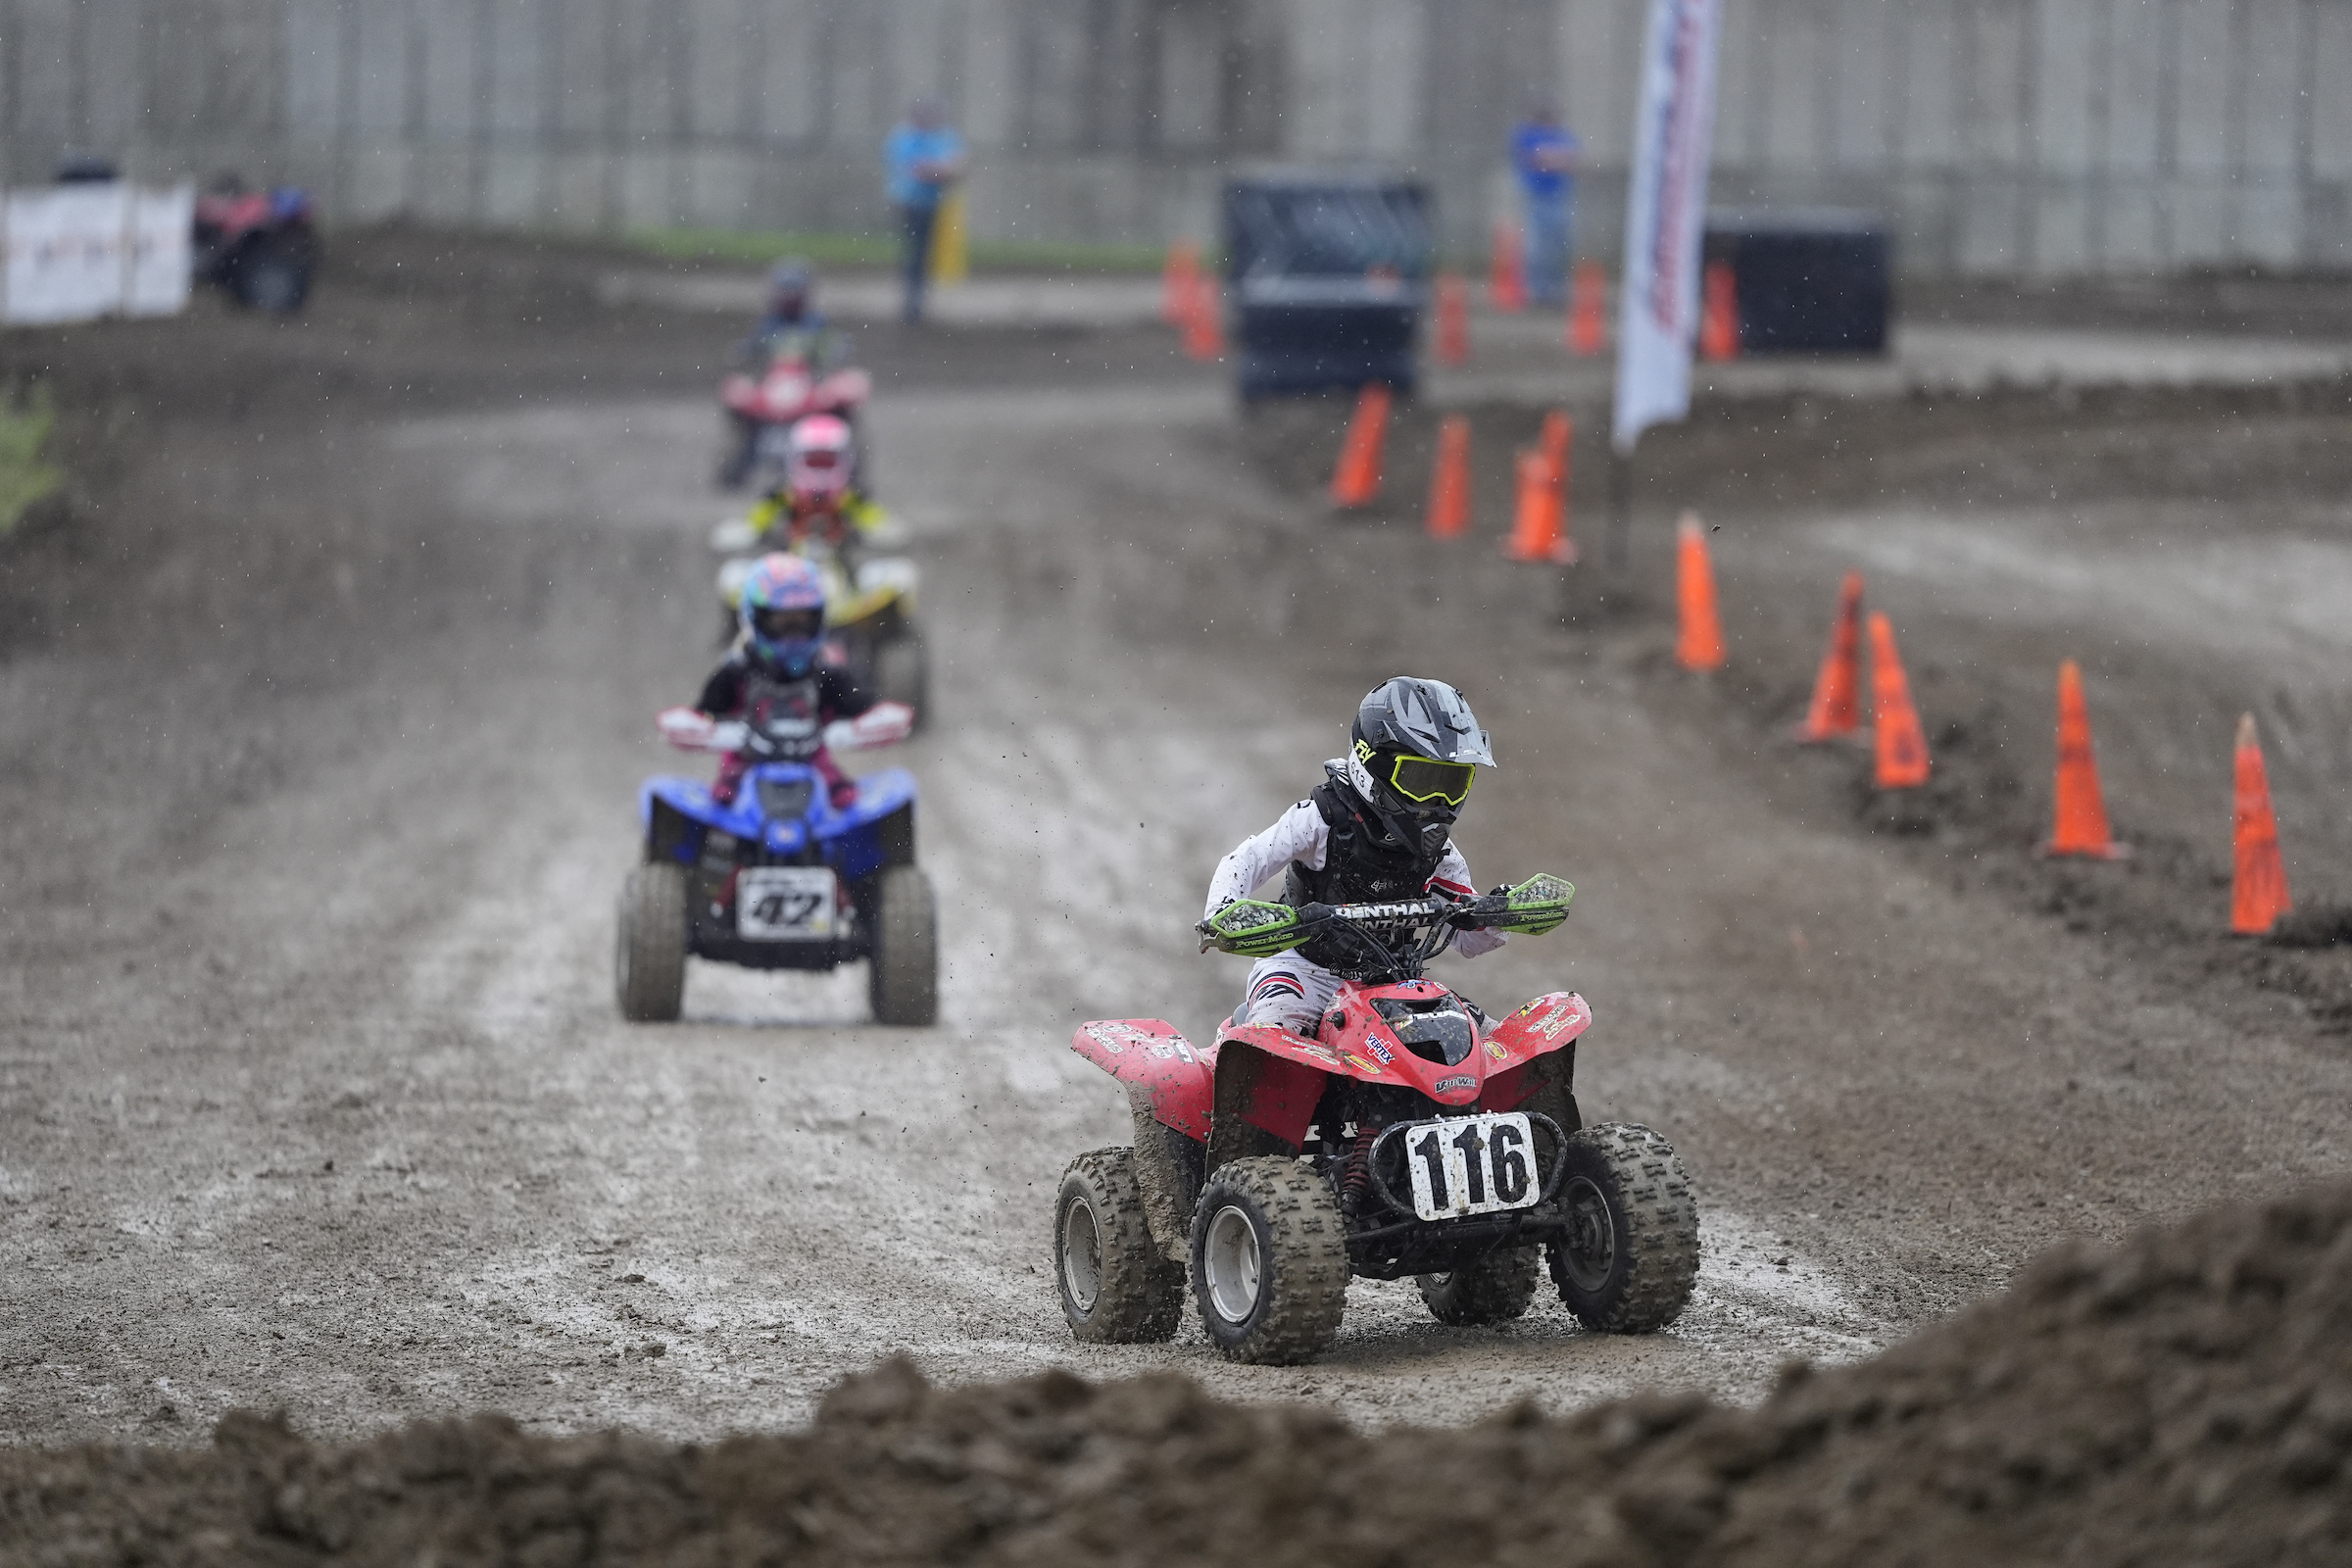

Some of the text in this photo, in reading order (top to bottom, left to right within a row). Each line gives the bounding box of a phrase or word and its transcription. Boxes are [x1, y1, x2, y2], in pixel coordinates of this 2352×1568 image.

[1354, 738, 1377, 764] FLY
[1351, 761, 1365, 788] 613
[753, 893, 822, 926] 42
[1368, 1034, 1392, 1063] VERTEX
[1414, 1123, 1528, 1211] 116
